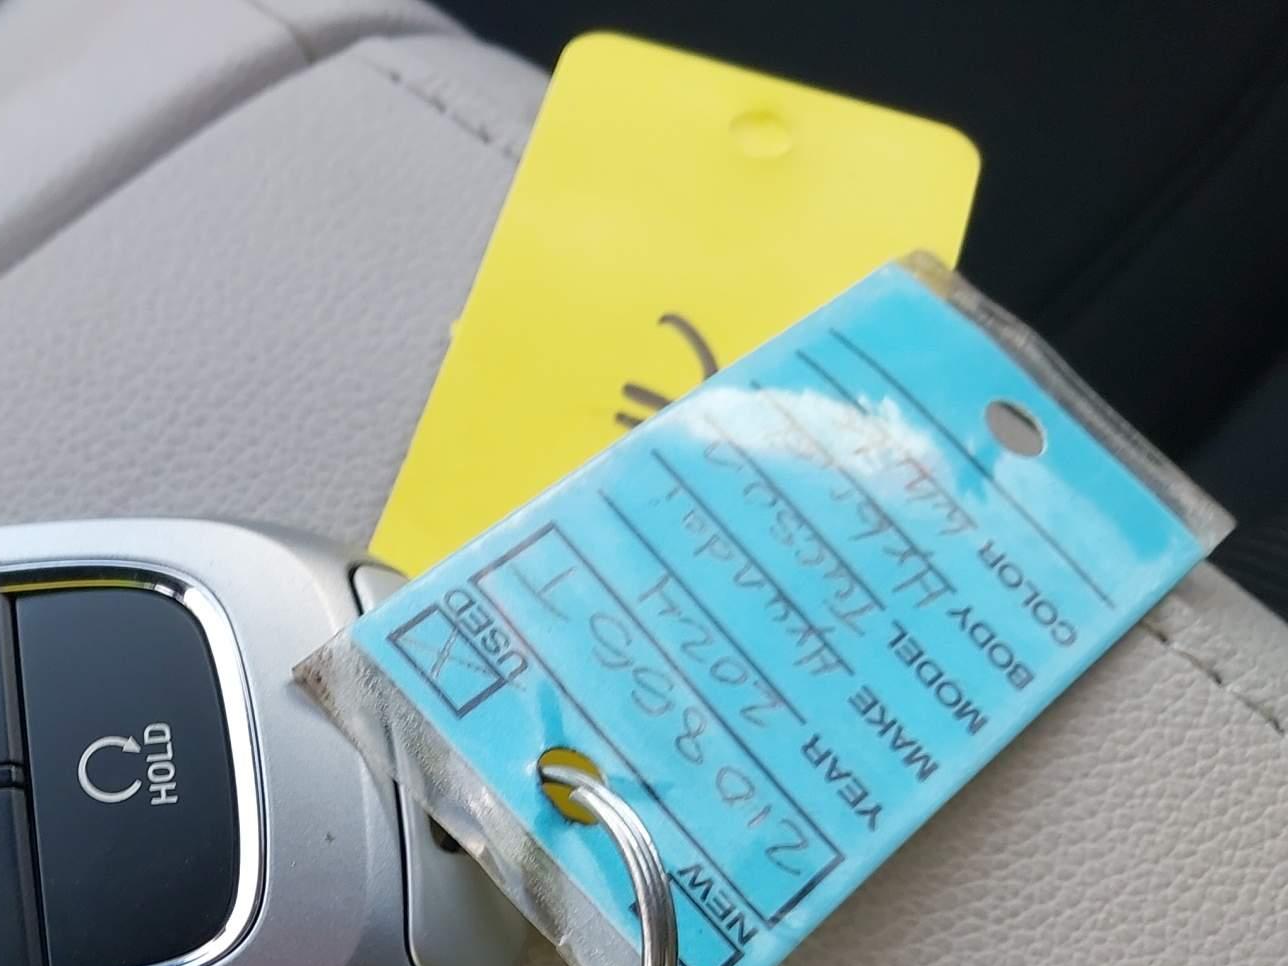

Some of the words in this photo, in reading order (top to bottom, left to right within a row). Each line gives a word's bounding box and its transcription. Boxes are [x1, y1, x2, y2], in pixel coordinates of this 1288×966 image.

[446, 588, 526, 681] USED
[979, 539, 1074, 646] COLOR
[638, 576, 783, 725] 2024
[888, 622, 989, 736] MODEL
[946, 609, 1035, 692] BODY
[144, 723, 178, 806] HOLD
[803, 734, 884, 831] YEAR
[847, 685, 939, 783] MAKE
[676, 866, 759, 946] NEW
